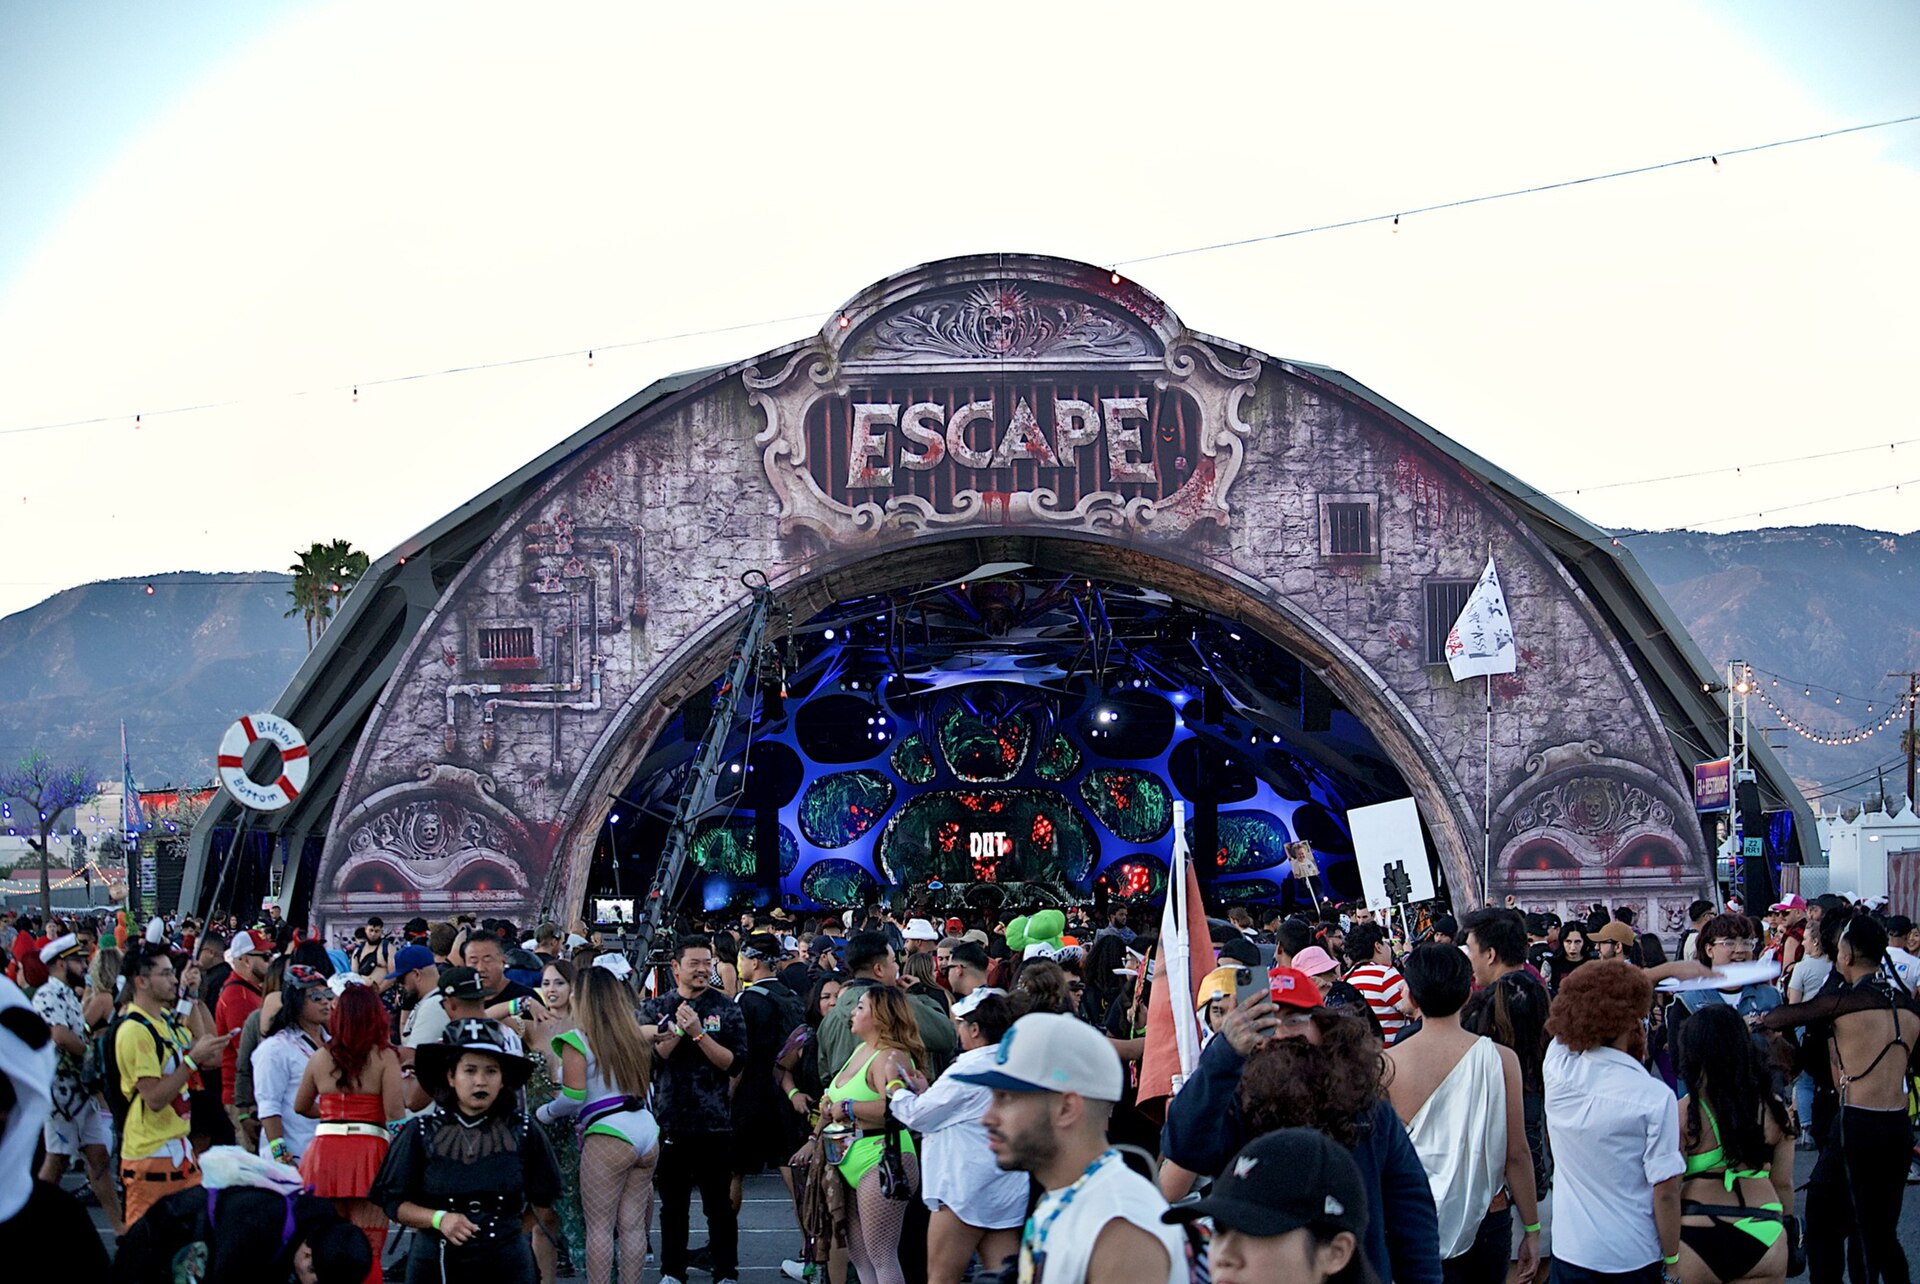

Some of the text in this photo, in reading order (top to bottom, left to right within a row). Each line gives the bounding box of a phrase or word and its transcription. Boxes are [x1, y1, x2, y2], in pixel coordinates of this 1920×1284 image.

[845, 396, 1158, 488] ESCAPE
[257, 721, 296, 746] Bikini
[233, 778, 278, 803] Bottom
[1745, 846, 1760, 854] RR1
